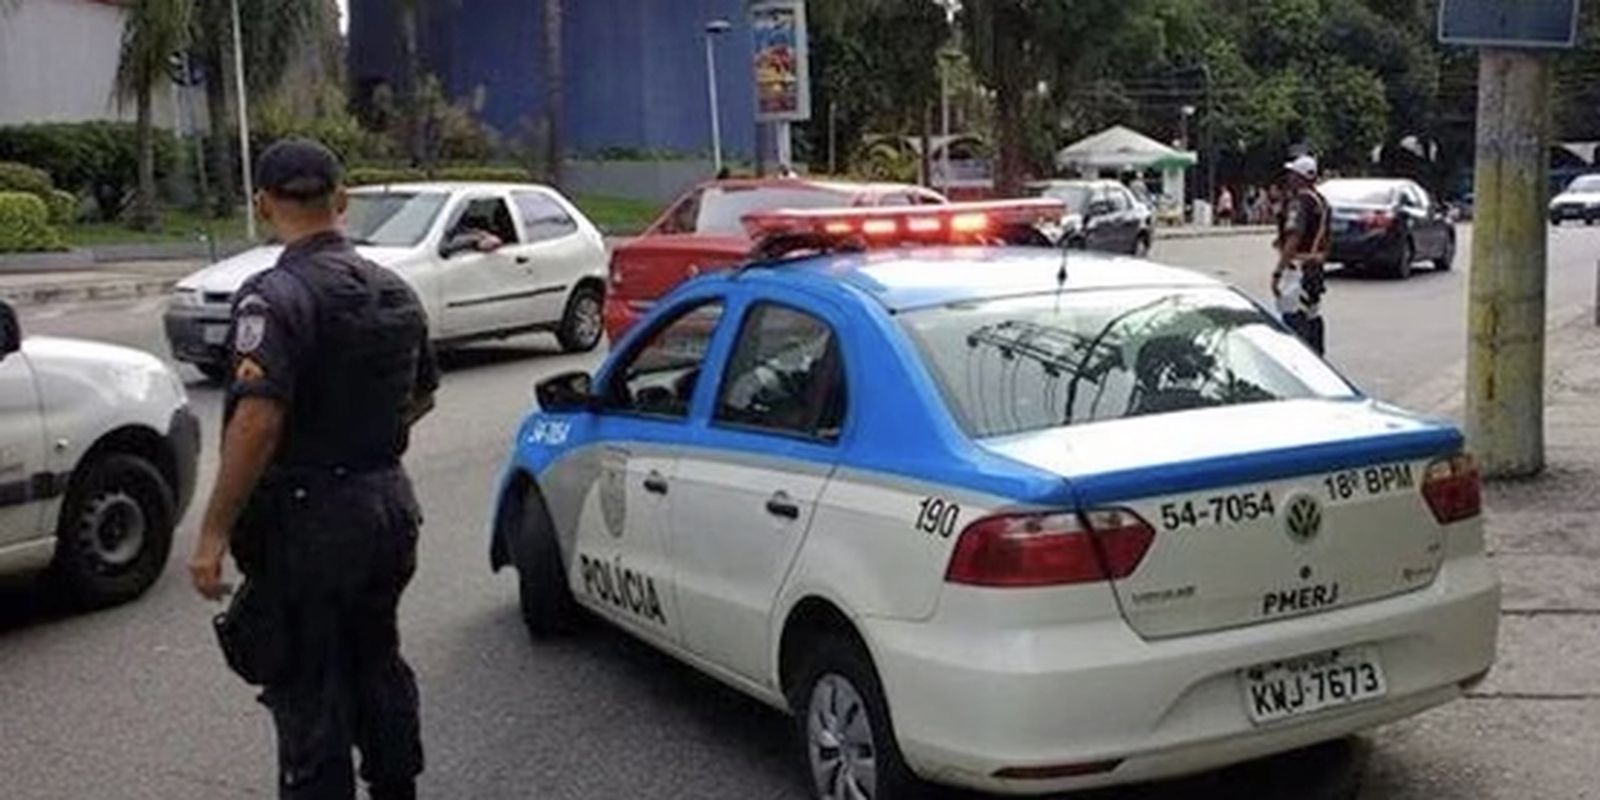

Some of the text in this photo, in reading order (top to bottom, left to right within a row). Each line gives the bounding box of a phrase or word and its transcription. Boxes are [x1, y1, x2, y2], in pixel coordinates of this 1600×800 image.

[1364, 464, 1414, 494] BPM
[914, 497, 960, 538] 190
[1160, 490, 1275, 531] 54-7054
[580, 553, 668, 626] POLÍCIA
[1263, 582, 1339, 616] PMERJ
